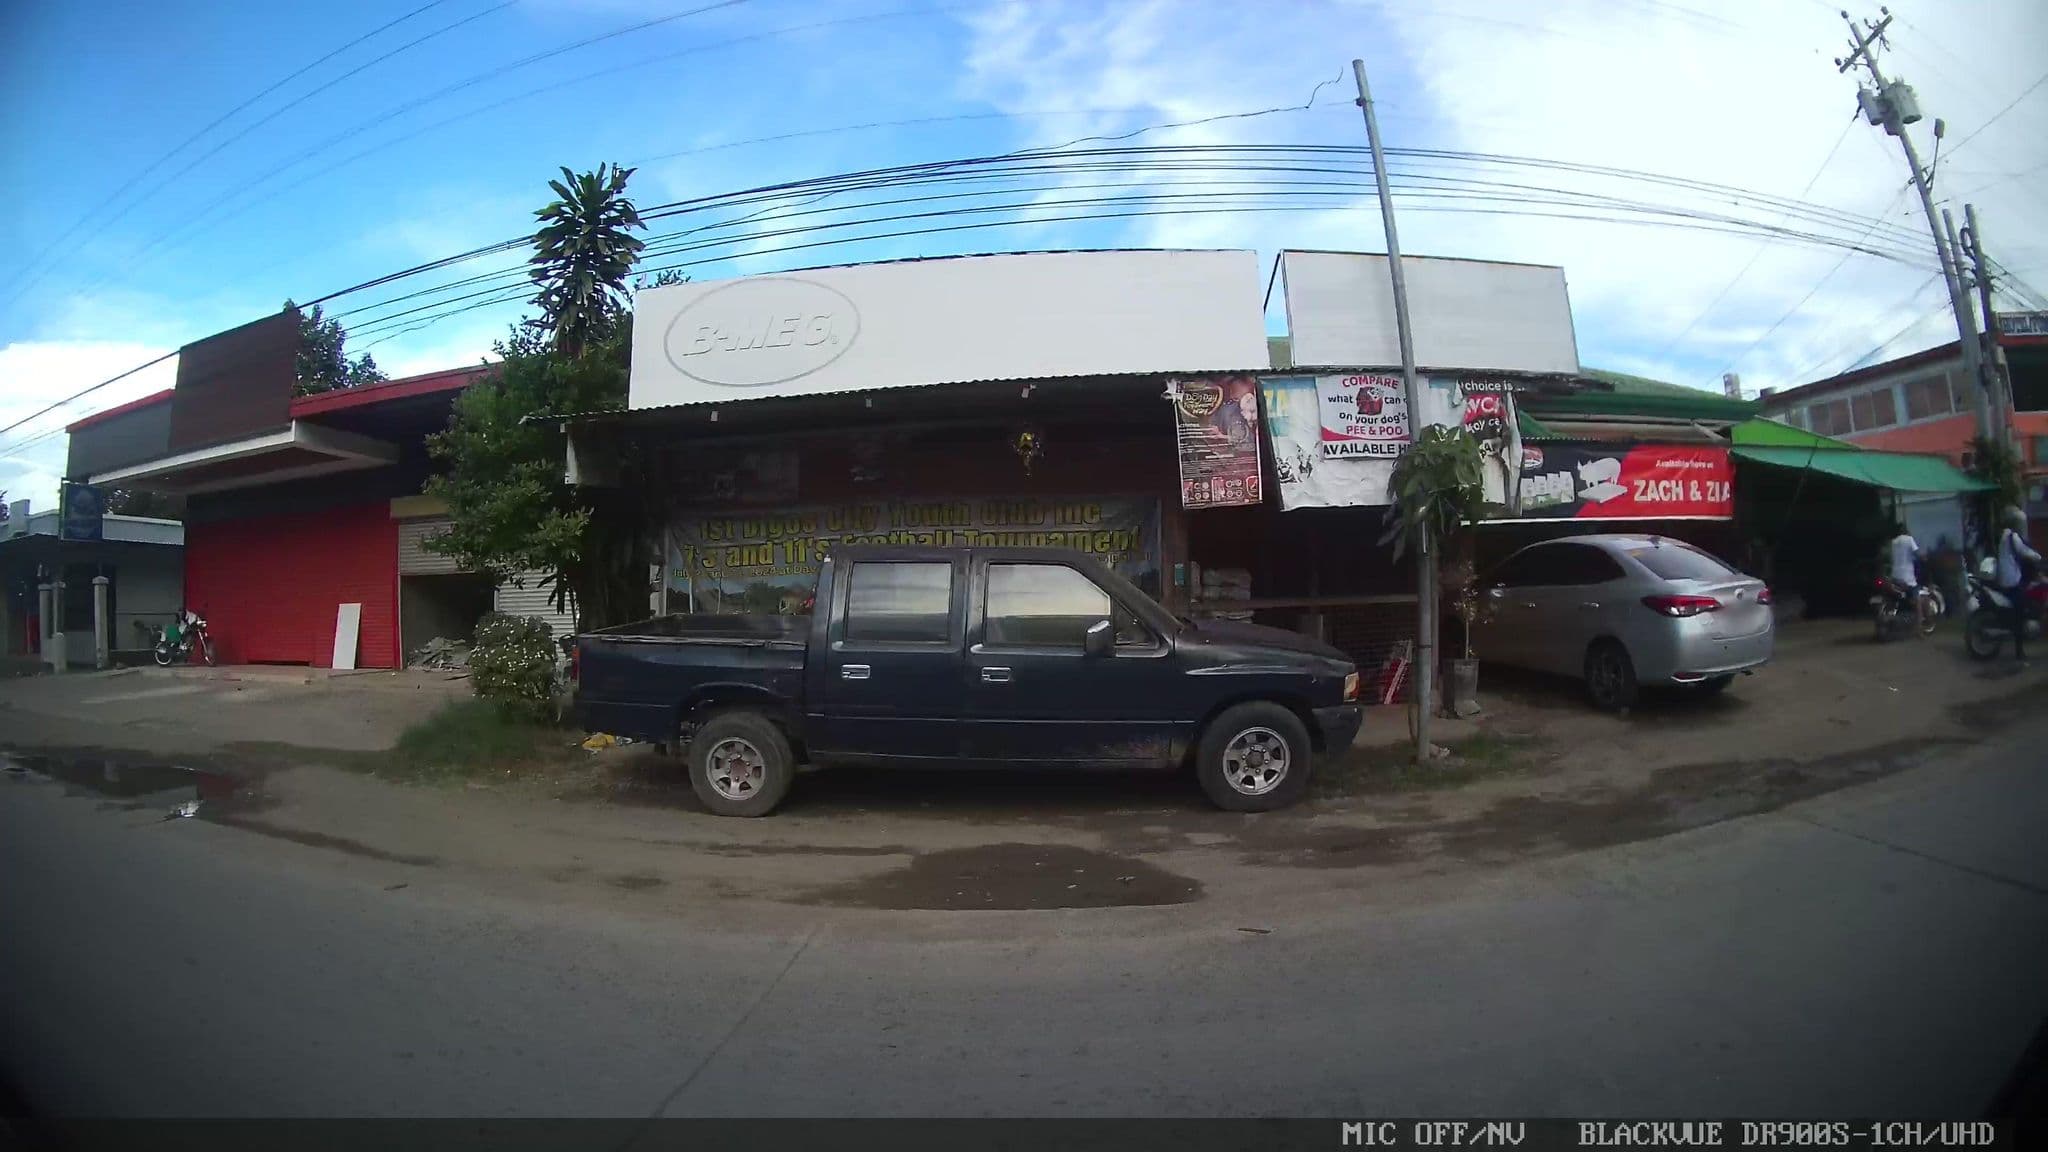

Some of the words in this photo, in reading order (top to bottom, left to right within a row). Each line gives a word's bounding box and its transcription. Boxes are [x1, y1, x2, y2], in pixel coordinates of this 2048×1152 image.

[1342, 375, 1399, 390] COMPARE
[1464, 380, 1501, 391] choice
[1328, 394, 1353, 404] what
[1384, 397, 1400, 405] can
[1339, 412, 1352, 421] on
[1355, 414, 1378, 425] your
[1380, 412, 1407, 424] dog's
[1346, 425, 1366, 435] PEE
[1368, 426, 1376, 435] &
[1379, 426, 1402, 436] POO
[1323, 443, 1395, 455] AVAILABLE
[1634, 479, 1683, 502] ZACH
[1690, 480, 1702, 502] &
[725, 541, 775, 568] and
[780, 537, 832, 564] 11's
